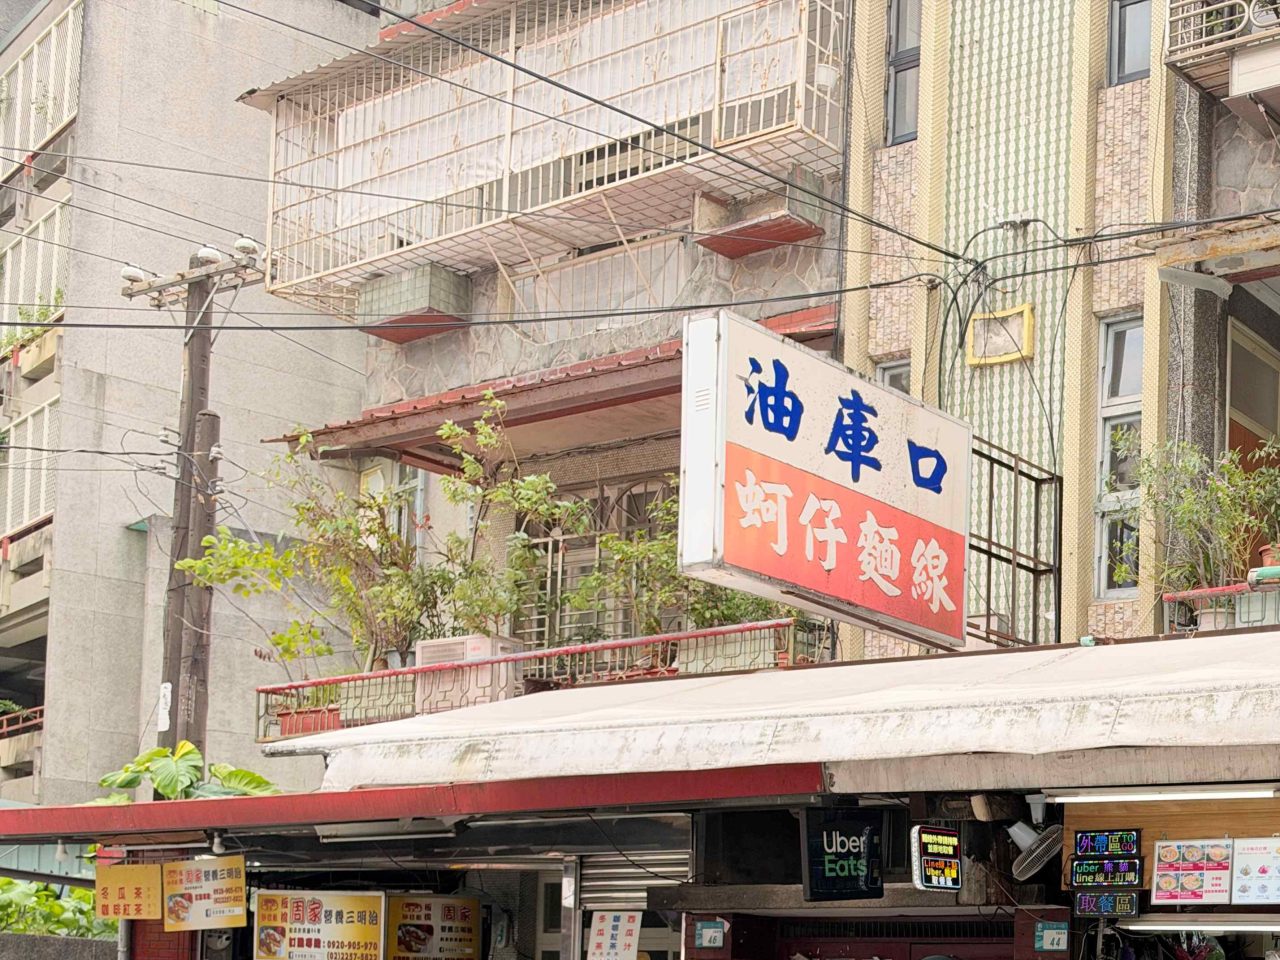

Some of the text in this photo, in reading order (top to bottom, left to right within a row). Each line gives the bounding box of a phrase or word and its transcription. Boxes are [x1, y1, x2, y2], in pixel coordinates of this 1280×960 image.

[744, 357, 948, 495] 油庫口
[735, 469, 957, 614] 蚵仔麵線
[823, 831, 866, 853] Uber
[1080, 835, 1121, 852] 外帶區
[824, 855, 867, 877] Eats
[1077, 864, 1099, 873] uber
[101, 887, 143, 899] 冬瓜茶
[290, 897, 378, 925] 周家 營養三明治
[1081, 896, 1131, 912] 取餐區
[708, 936, 717, 944] 46
[1050, 937, 1061, 947] 44
